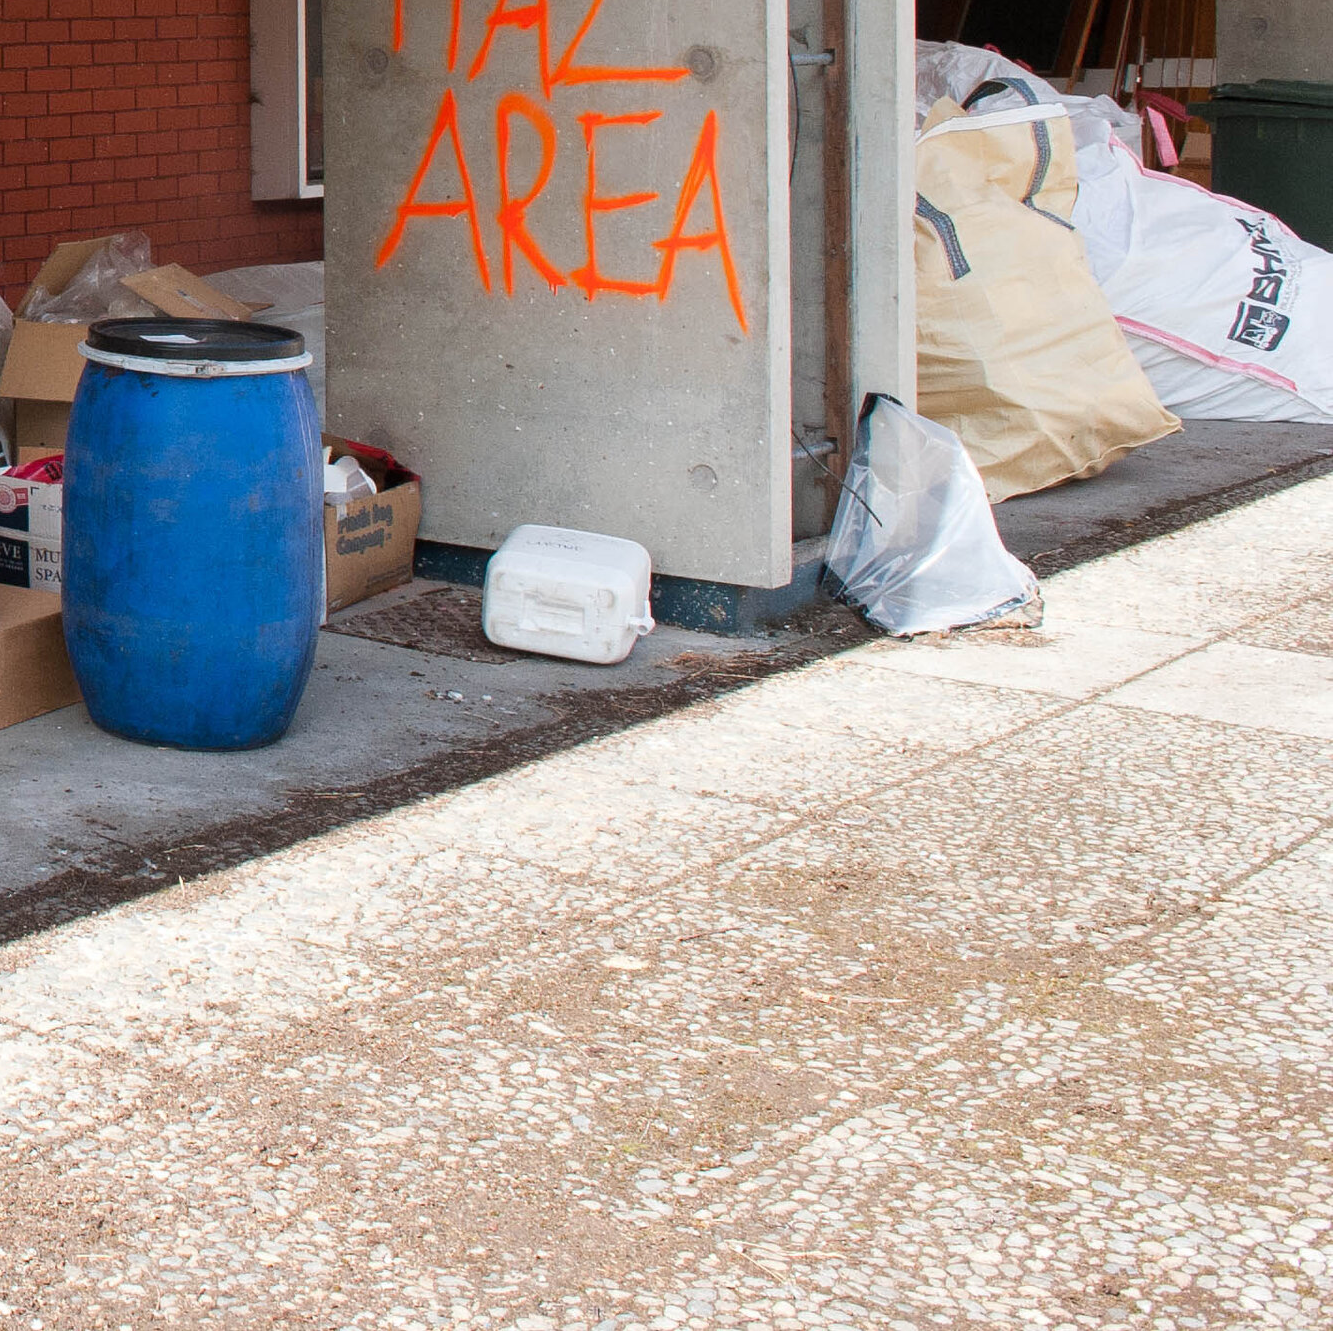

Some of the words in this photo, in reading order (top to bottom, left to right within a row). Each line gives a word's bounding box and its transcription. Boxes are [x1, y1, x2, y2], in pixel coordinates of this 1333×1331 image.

[376, 88, 750, 338] AREA
[35, 548, 61, 564] MU
[35, 567, 62, 583] SPA
